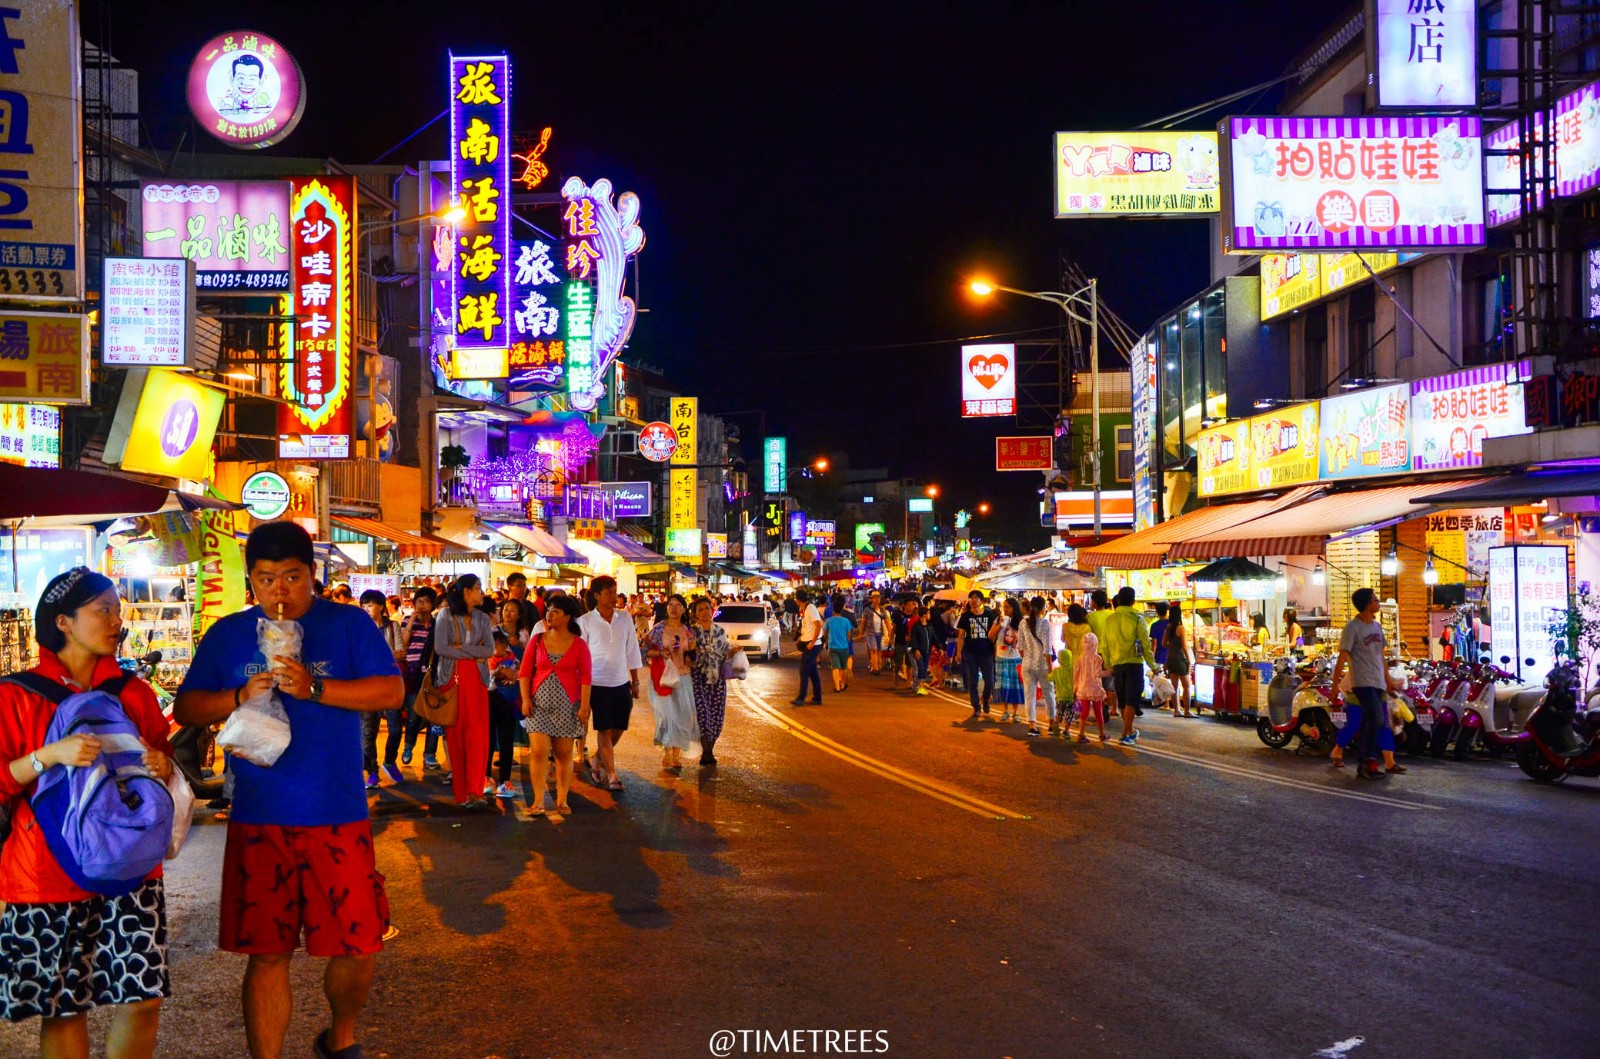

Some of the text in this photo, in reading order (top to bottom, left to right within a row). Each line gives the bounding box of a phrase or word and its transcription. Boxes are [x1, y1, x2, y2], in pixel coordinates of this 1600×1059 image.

[206, 35, 276, 61] 一品滷味
[1275, 139, 1442, 181] 拍貼娃娃
[455, 61, 502, 341] 旅南活海鮮
[1321, 194, 1396, 228] 樂園
[1, 244, 67, 267] 活動票券
[144, 212, 287, 264] 一品滷味
[564, 198, 601, 279] 佳珍
[112, 263, 180, 277] 南味小館
[300, 219, 333, 339] 沙哇帝卡
[514, 239, 562, 338] 旅南
[36, 322, 78, 394] 旅南
[509, 341, 567, 366] 活海鮮
[965, 399, 1013, 415] 萊爾富
[1432, 384, 1509, 421] 拍貼娃娃
[675, 402, 692, 460] 南台灣
